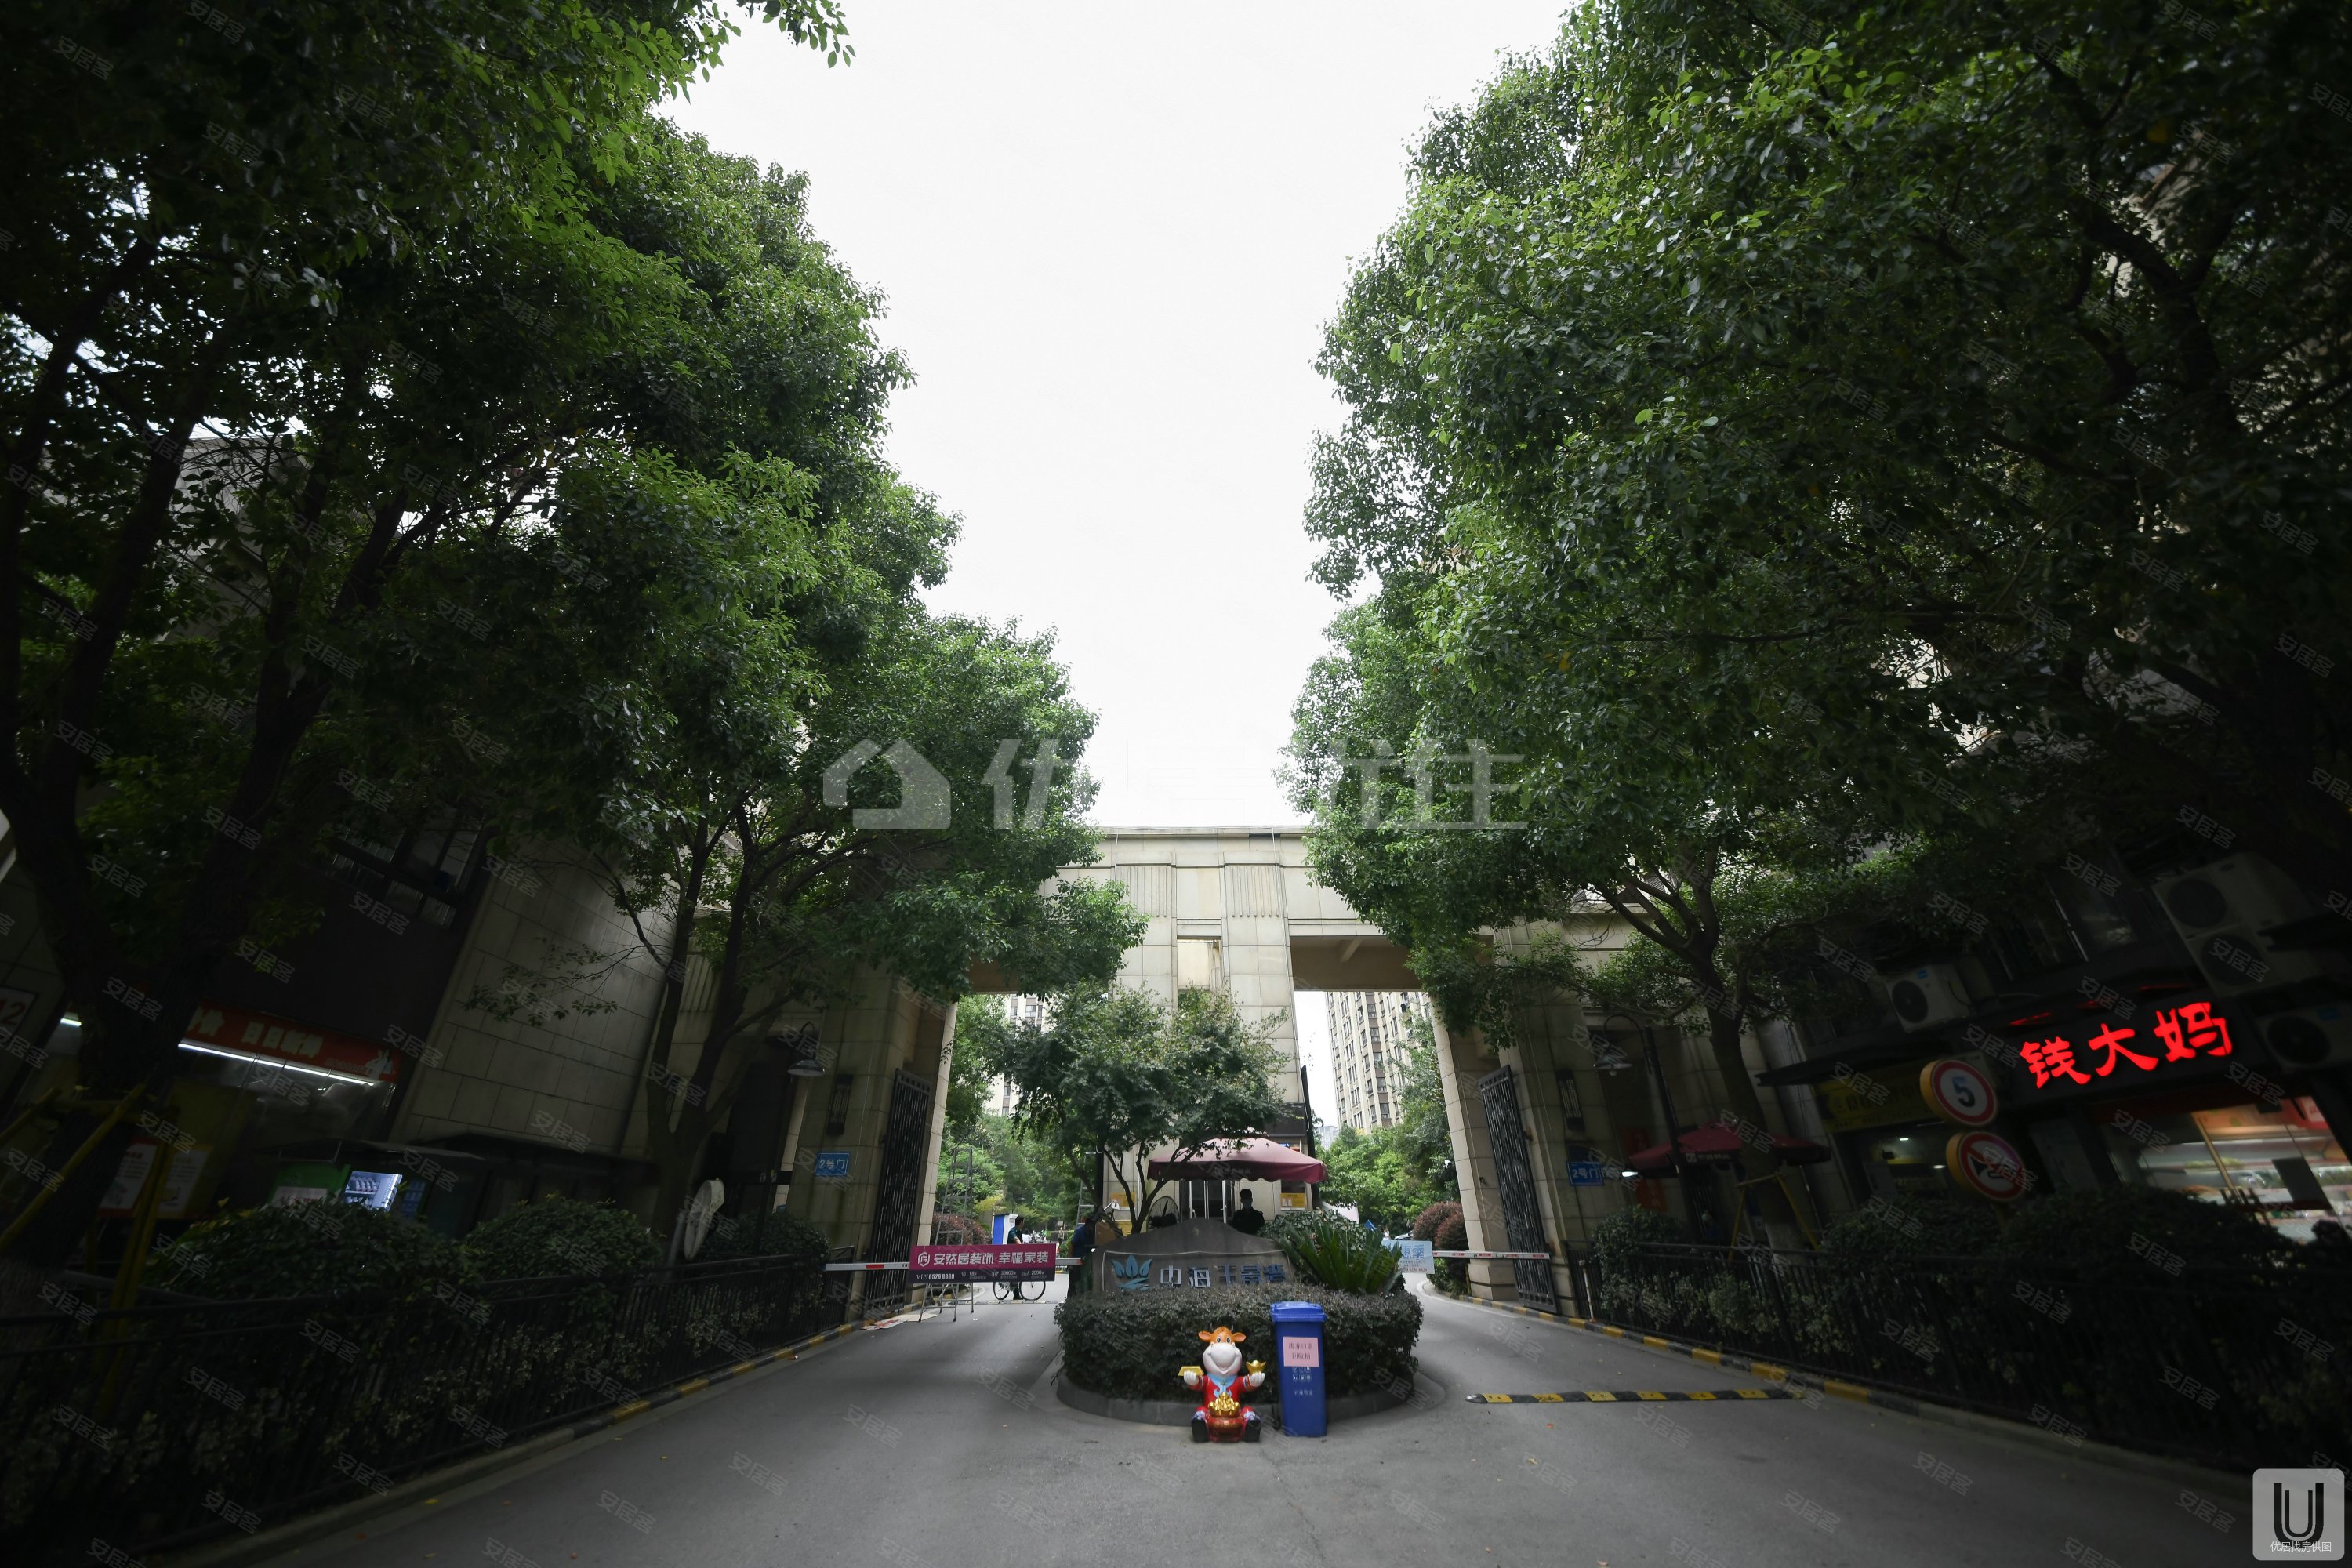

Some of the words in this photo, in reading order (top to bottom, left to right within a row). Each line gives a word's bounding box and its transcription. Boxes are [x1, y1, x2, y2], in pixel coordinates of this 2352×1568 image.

[2020, 1001, 2233, 1089] 钱大妈
[1951, 1076, 1976, 1107] 5
[818, 1159, 846, 1170] 2号门
[1572, 1167, 1599, 1179] 2号门
